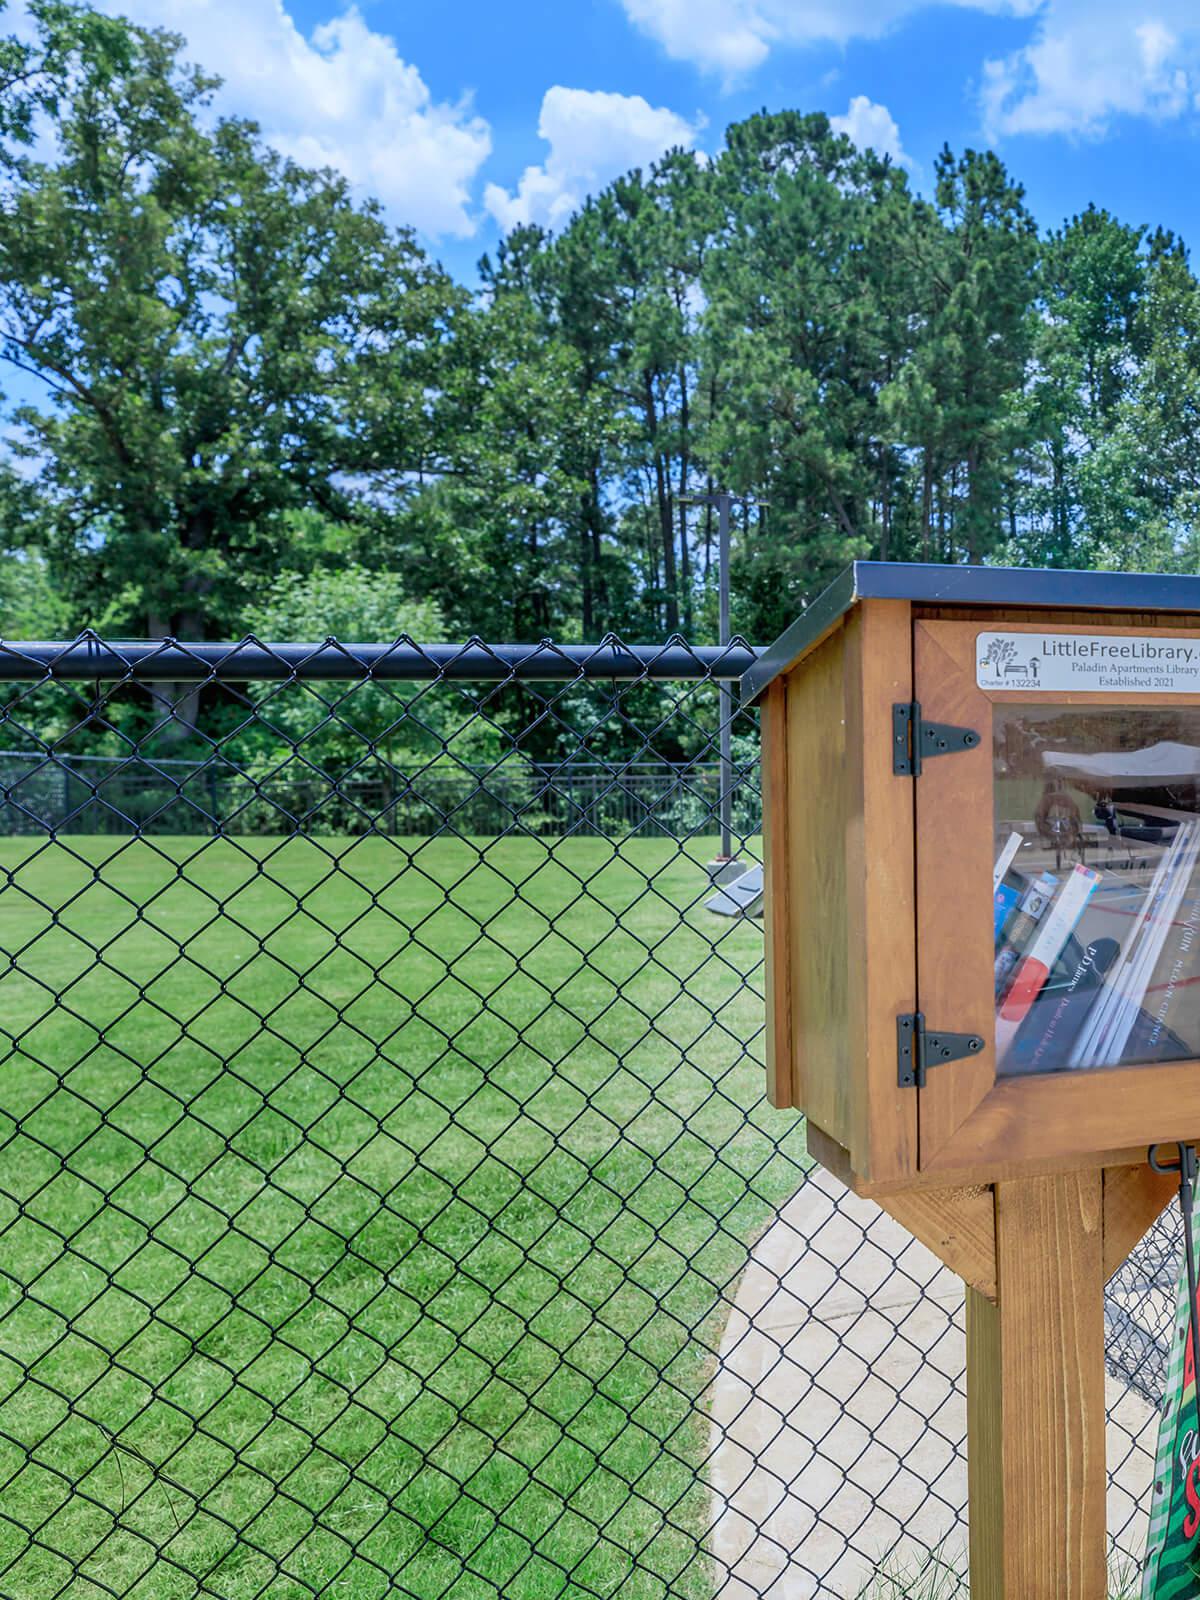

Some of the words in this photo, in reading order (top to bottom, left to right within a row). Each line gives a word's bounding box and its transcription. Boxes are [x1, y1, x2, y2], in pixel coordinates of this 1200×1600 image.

[1071, 662, 1108, 673] Paladin
[1110, 663, 1164, 675] Apartments
[1166, 664, 1200, 677] Library
[1011, 679, 1041, 688] 132234
[1099, 676, 1153, 687] Established
[1154, 677, 1174, 687] 2021
